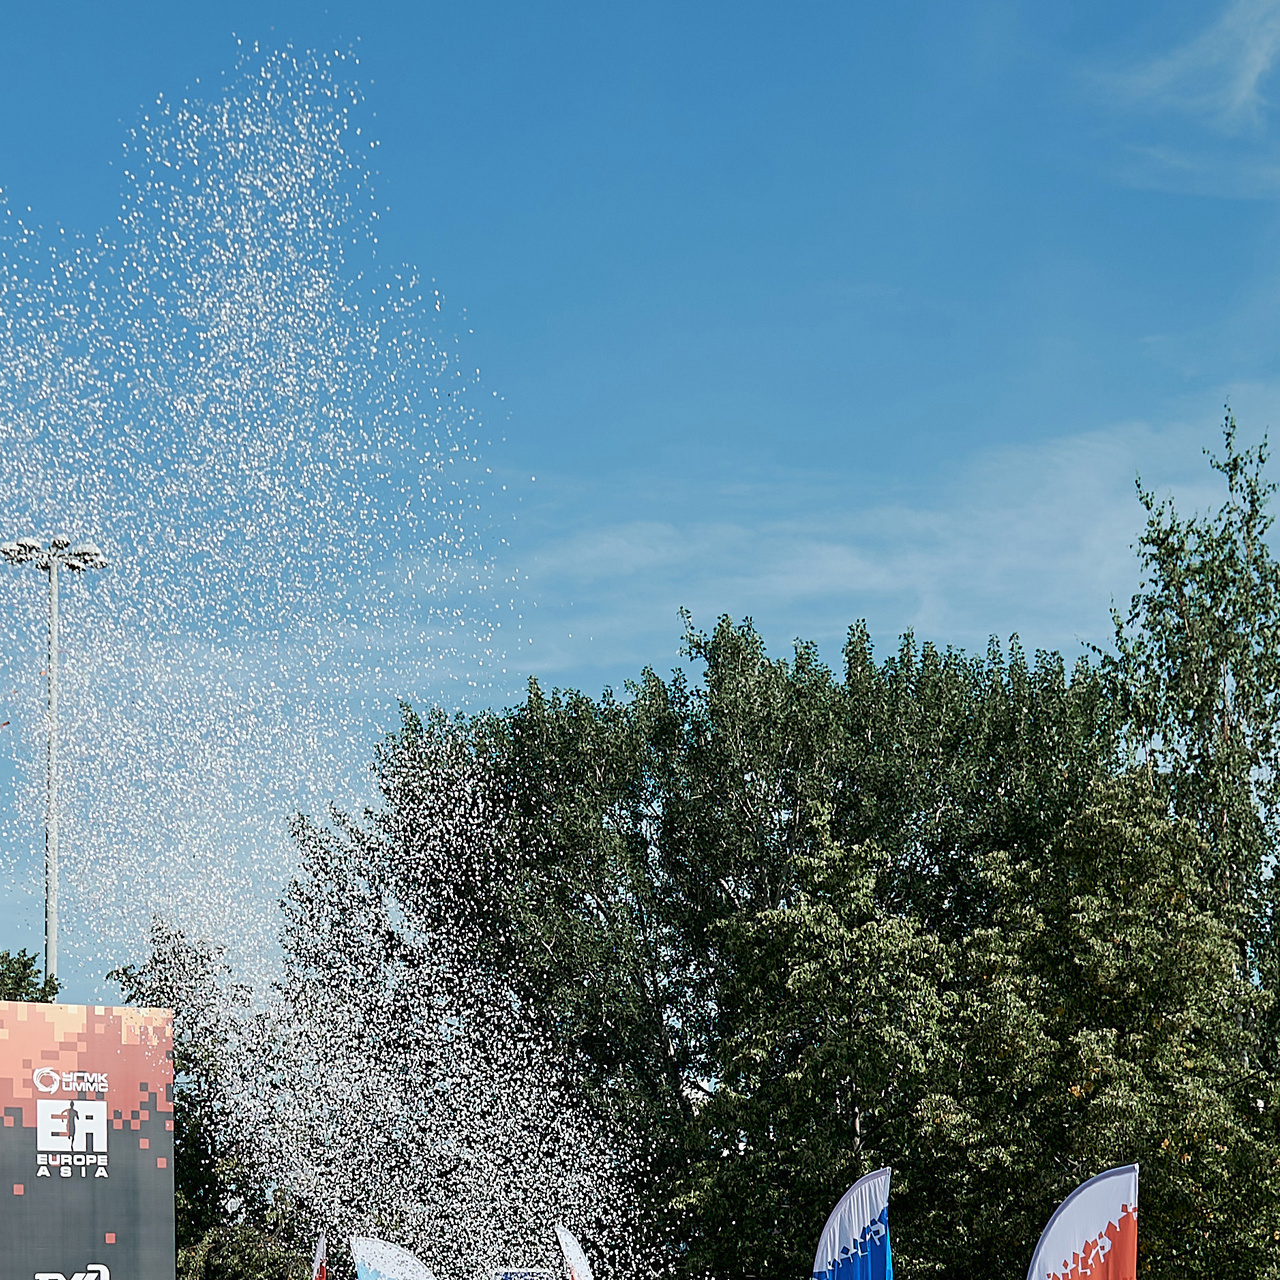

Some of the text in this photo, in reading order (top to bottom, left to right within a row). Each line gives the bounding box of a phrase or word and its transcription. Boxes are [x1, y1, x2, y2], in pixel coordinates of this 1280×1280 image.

[62, 1082, 109, 1092] UMMC
[36, 1153, 108, 1166] EUROPE
[36, 1165, 109, 1178] ASIA
